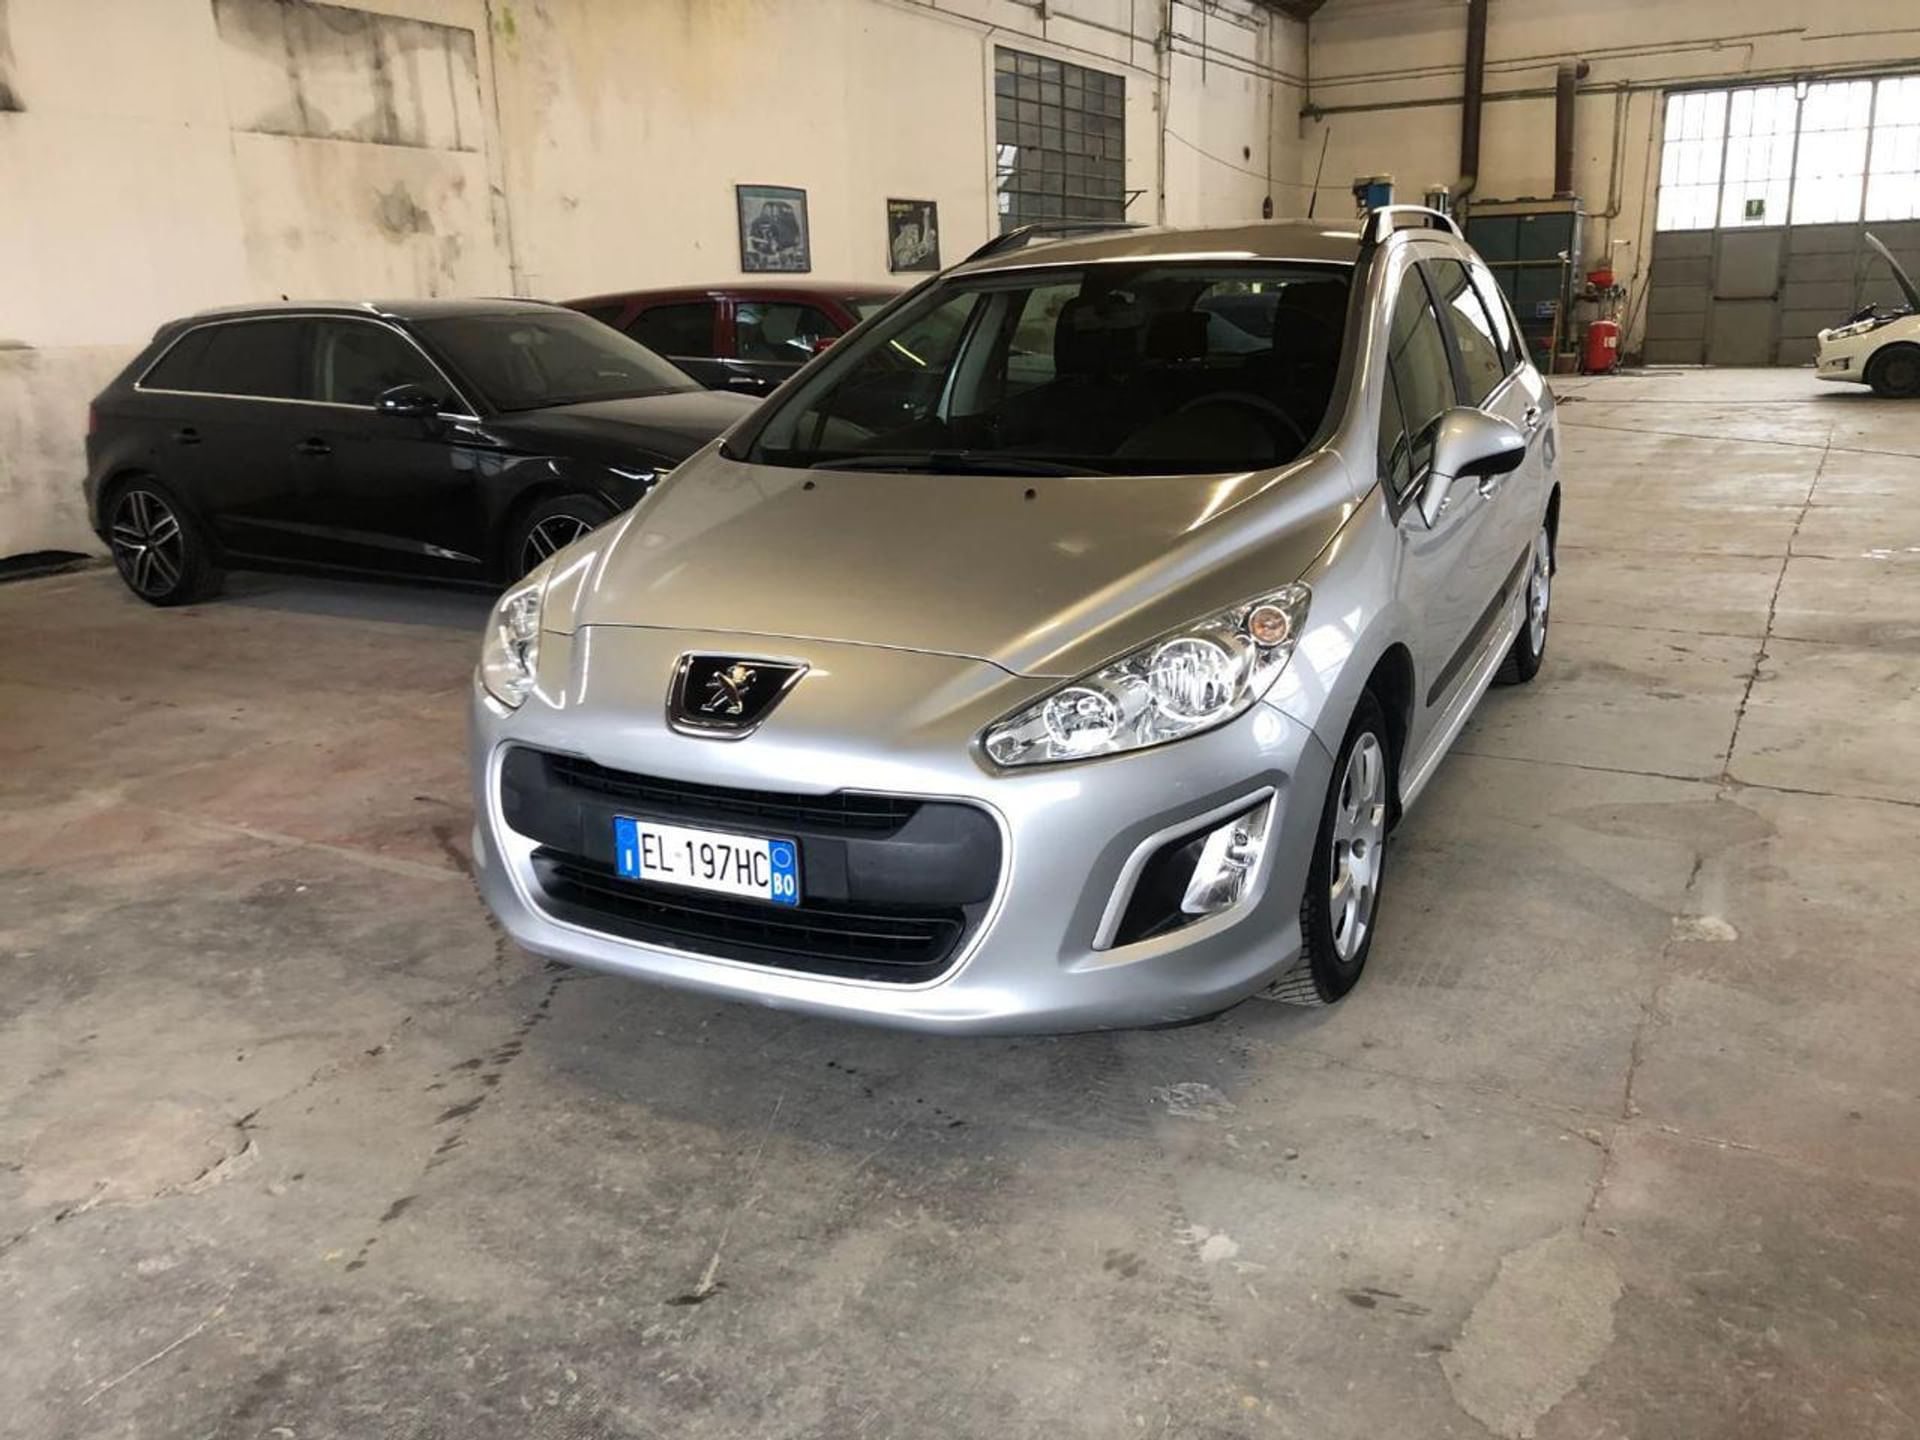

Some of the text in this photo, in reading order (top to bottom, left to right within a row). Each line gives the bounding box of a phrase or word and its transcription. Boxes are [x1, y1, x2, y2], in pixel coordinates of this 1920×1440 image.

[625, 849, 633, 871] I
[641, 833, 769, 888] EL 197HC
[773, 872, 795, 896] BO
